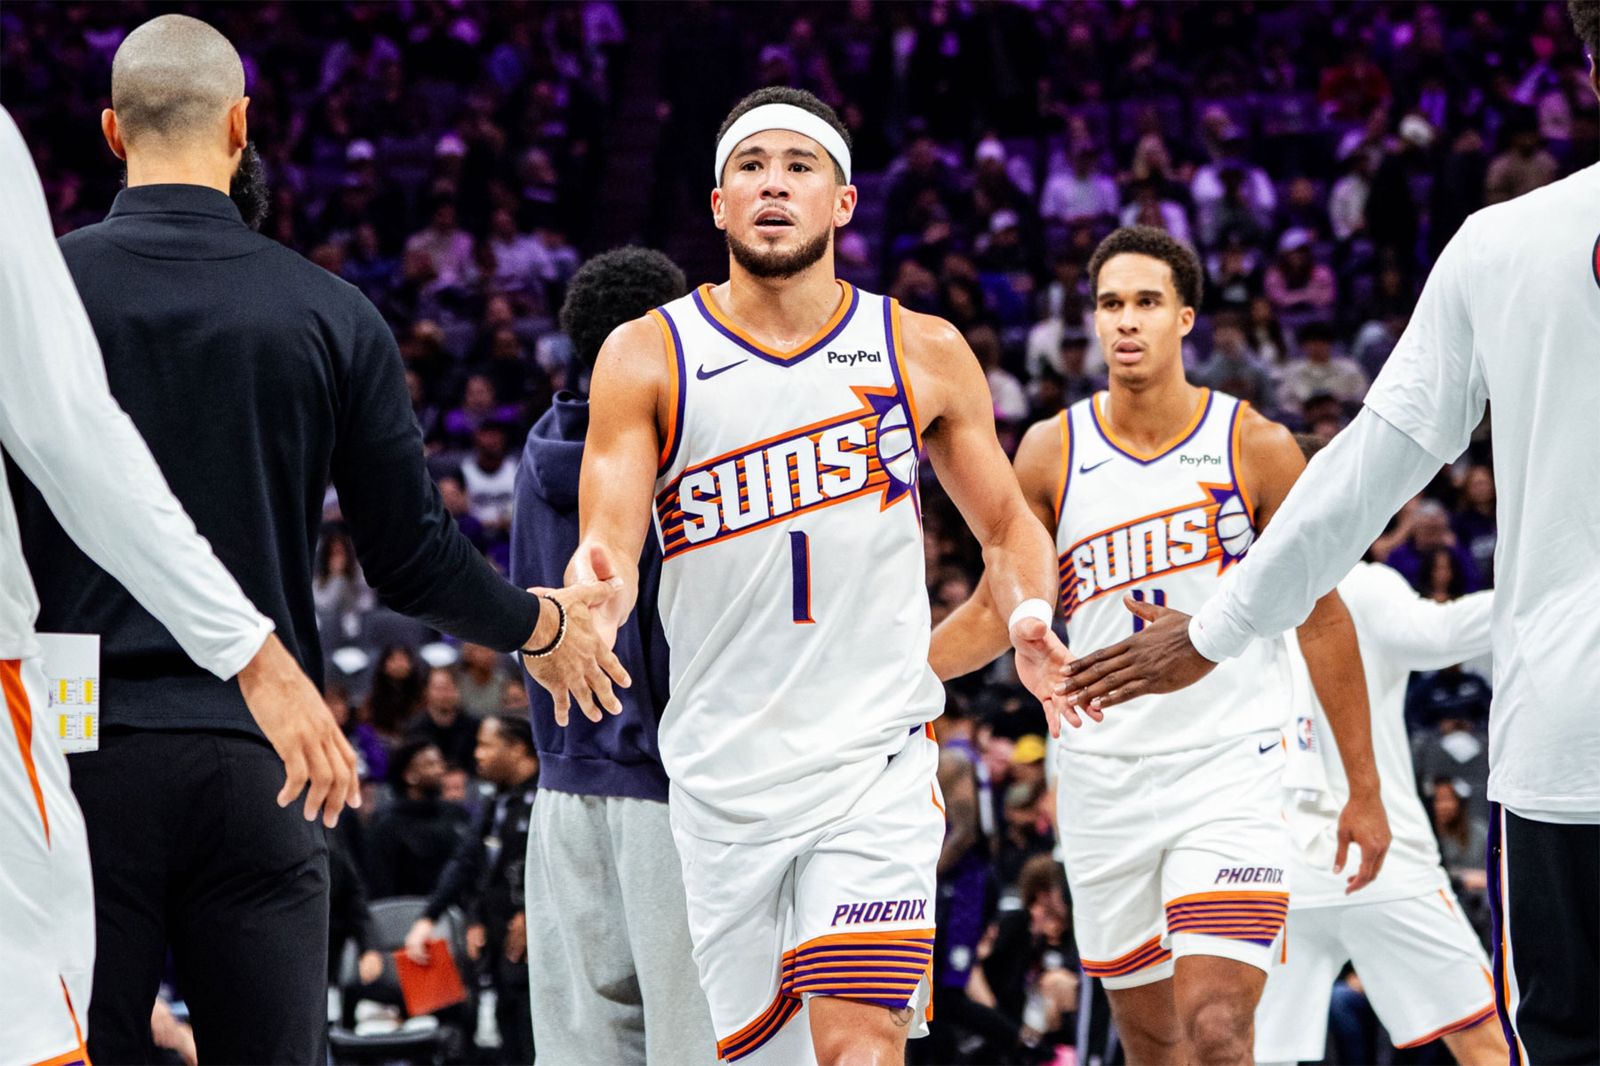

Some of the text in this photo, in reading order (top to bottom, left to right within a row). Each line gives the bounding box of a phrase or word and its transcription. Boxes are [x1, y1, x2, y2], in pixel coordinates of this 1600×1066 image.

[827, 350, 881, 366] PayPal
[1179, 455, 1222, 467] PayPal
[678, 421, 868, 544] SUNS
[1071, 508, 1208, 602] SUNS
[787, 530, 816, 624] 1
[1214, 867, 1284, 885] PHOENIX
[831, 899, 927, 927] PHOENIX
